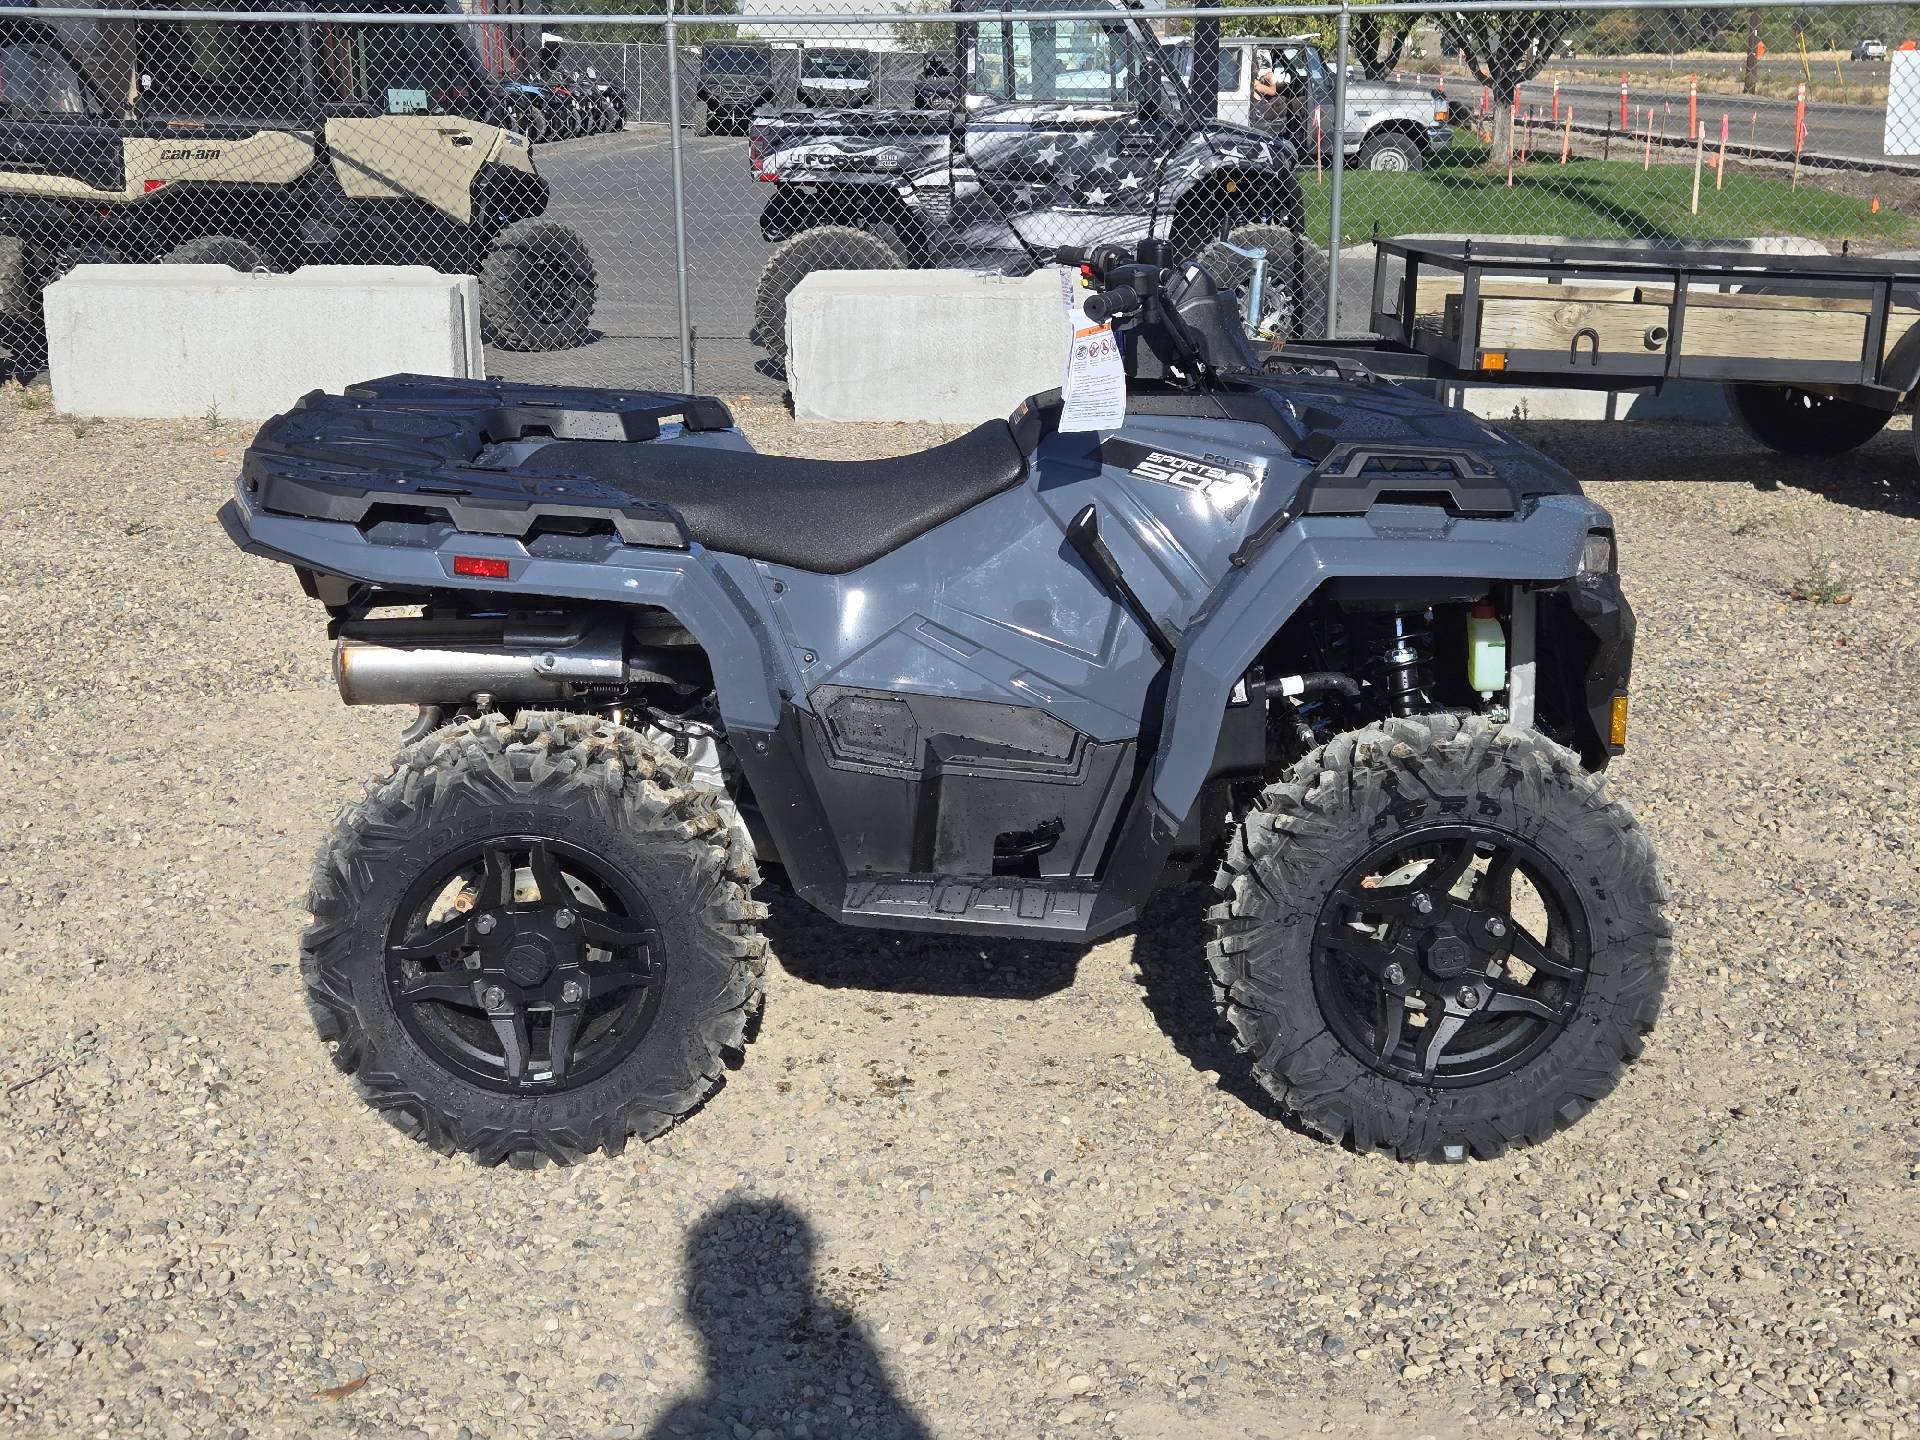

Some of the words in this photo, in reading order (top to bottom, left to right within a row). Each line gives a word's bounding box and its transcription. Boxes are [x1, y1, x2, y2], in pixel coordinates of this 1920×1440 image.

[160, 149, 221, 160] can-am
[1202, 452, 1270, 478] POLARS
[1130, 461, 1246, 502] 50
